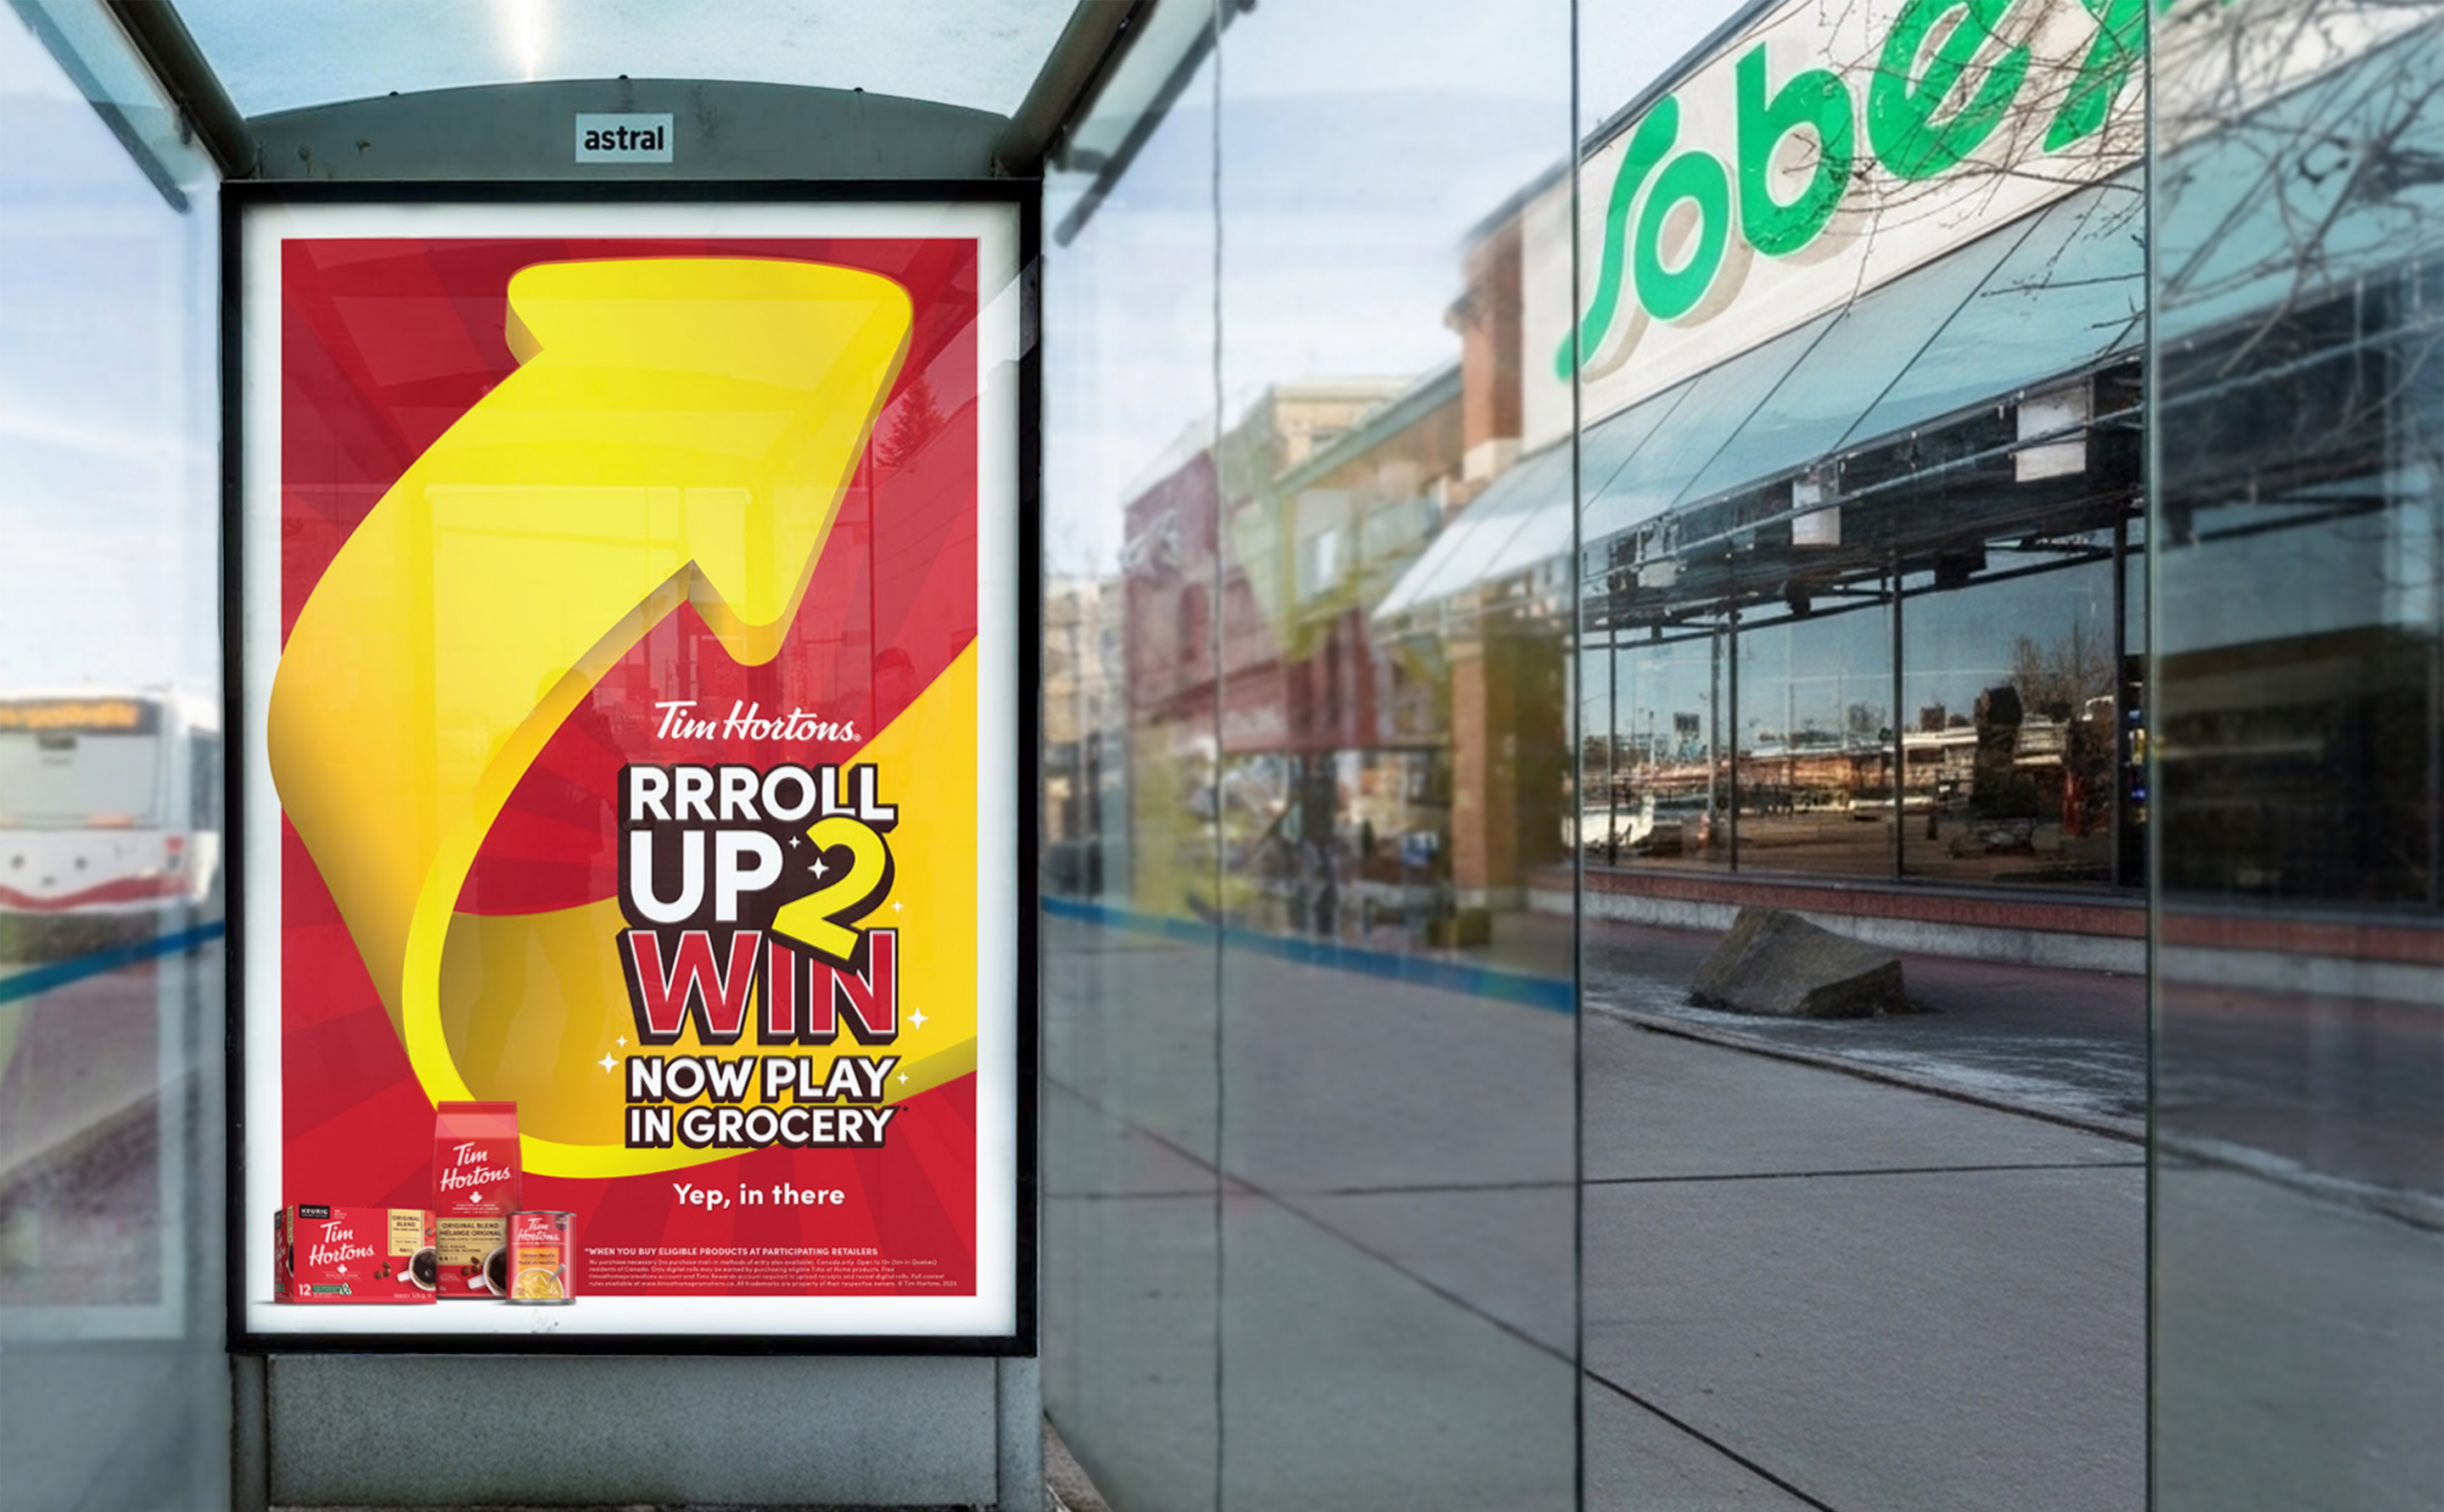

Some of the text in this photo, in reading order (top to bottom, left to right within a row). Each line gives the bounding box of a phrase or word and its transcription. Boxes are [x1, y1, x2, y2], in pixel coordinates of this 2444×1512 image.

[584, 126, 664, 150] astral
[654, 700, 717, 740] Tim
[630, 766, 895, 820] RRROLL
[630, 816, 886, 960] UP 2
[628, 930, 895, 1034] WIN
[631, 1058, 895, 1097] NOW PLAY
[631, 1108, 671, 1142] IN
[452, 1141, 488, 1167] Tim
[673, 1182, 845, 1211] Yep, in there
[320, 1221, 353, 1243] Tim
[528, 1218, 548, 1230] Tim
[309, 1243, 374, 1267] Hortons
[616, 1247, 637, 1256] YOU
[637, 1247, 658, 1256] BUY
[658, 1247, 698, 1256] ELIGIBLE
[698, 1247, 748, 1256] PRODUCTS
[749, 1247, 761, 1256] AT
[761, 1247, 830, 1256] PARTICIPATING
[831, 1247, 878, 1256] RETAILERS
[299, 1284, 311, 1296] 12
